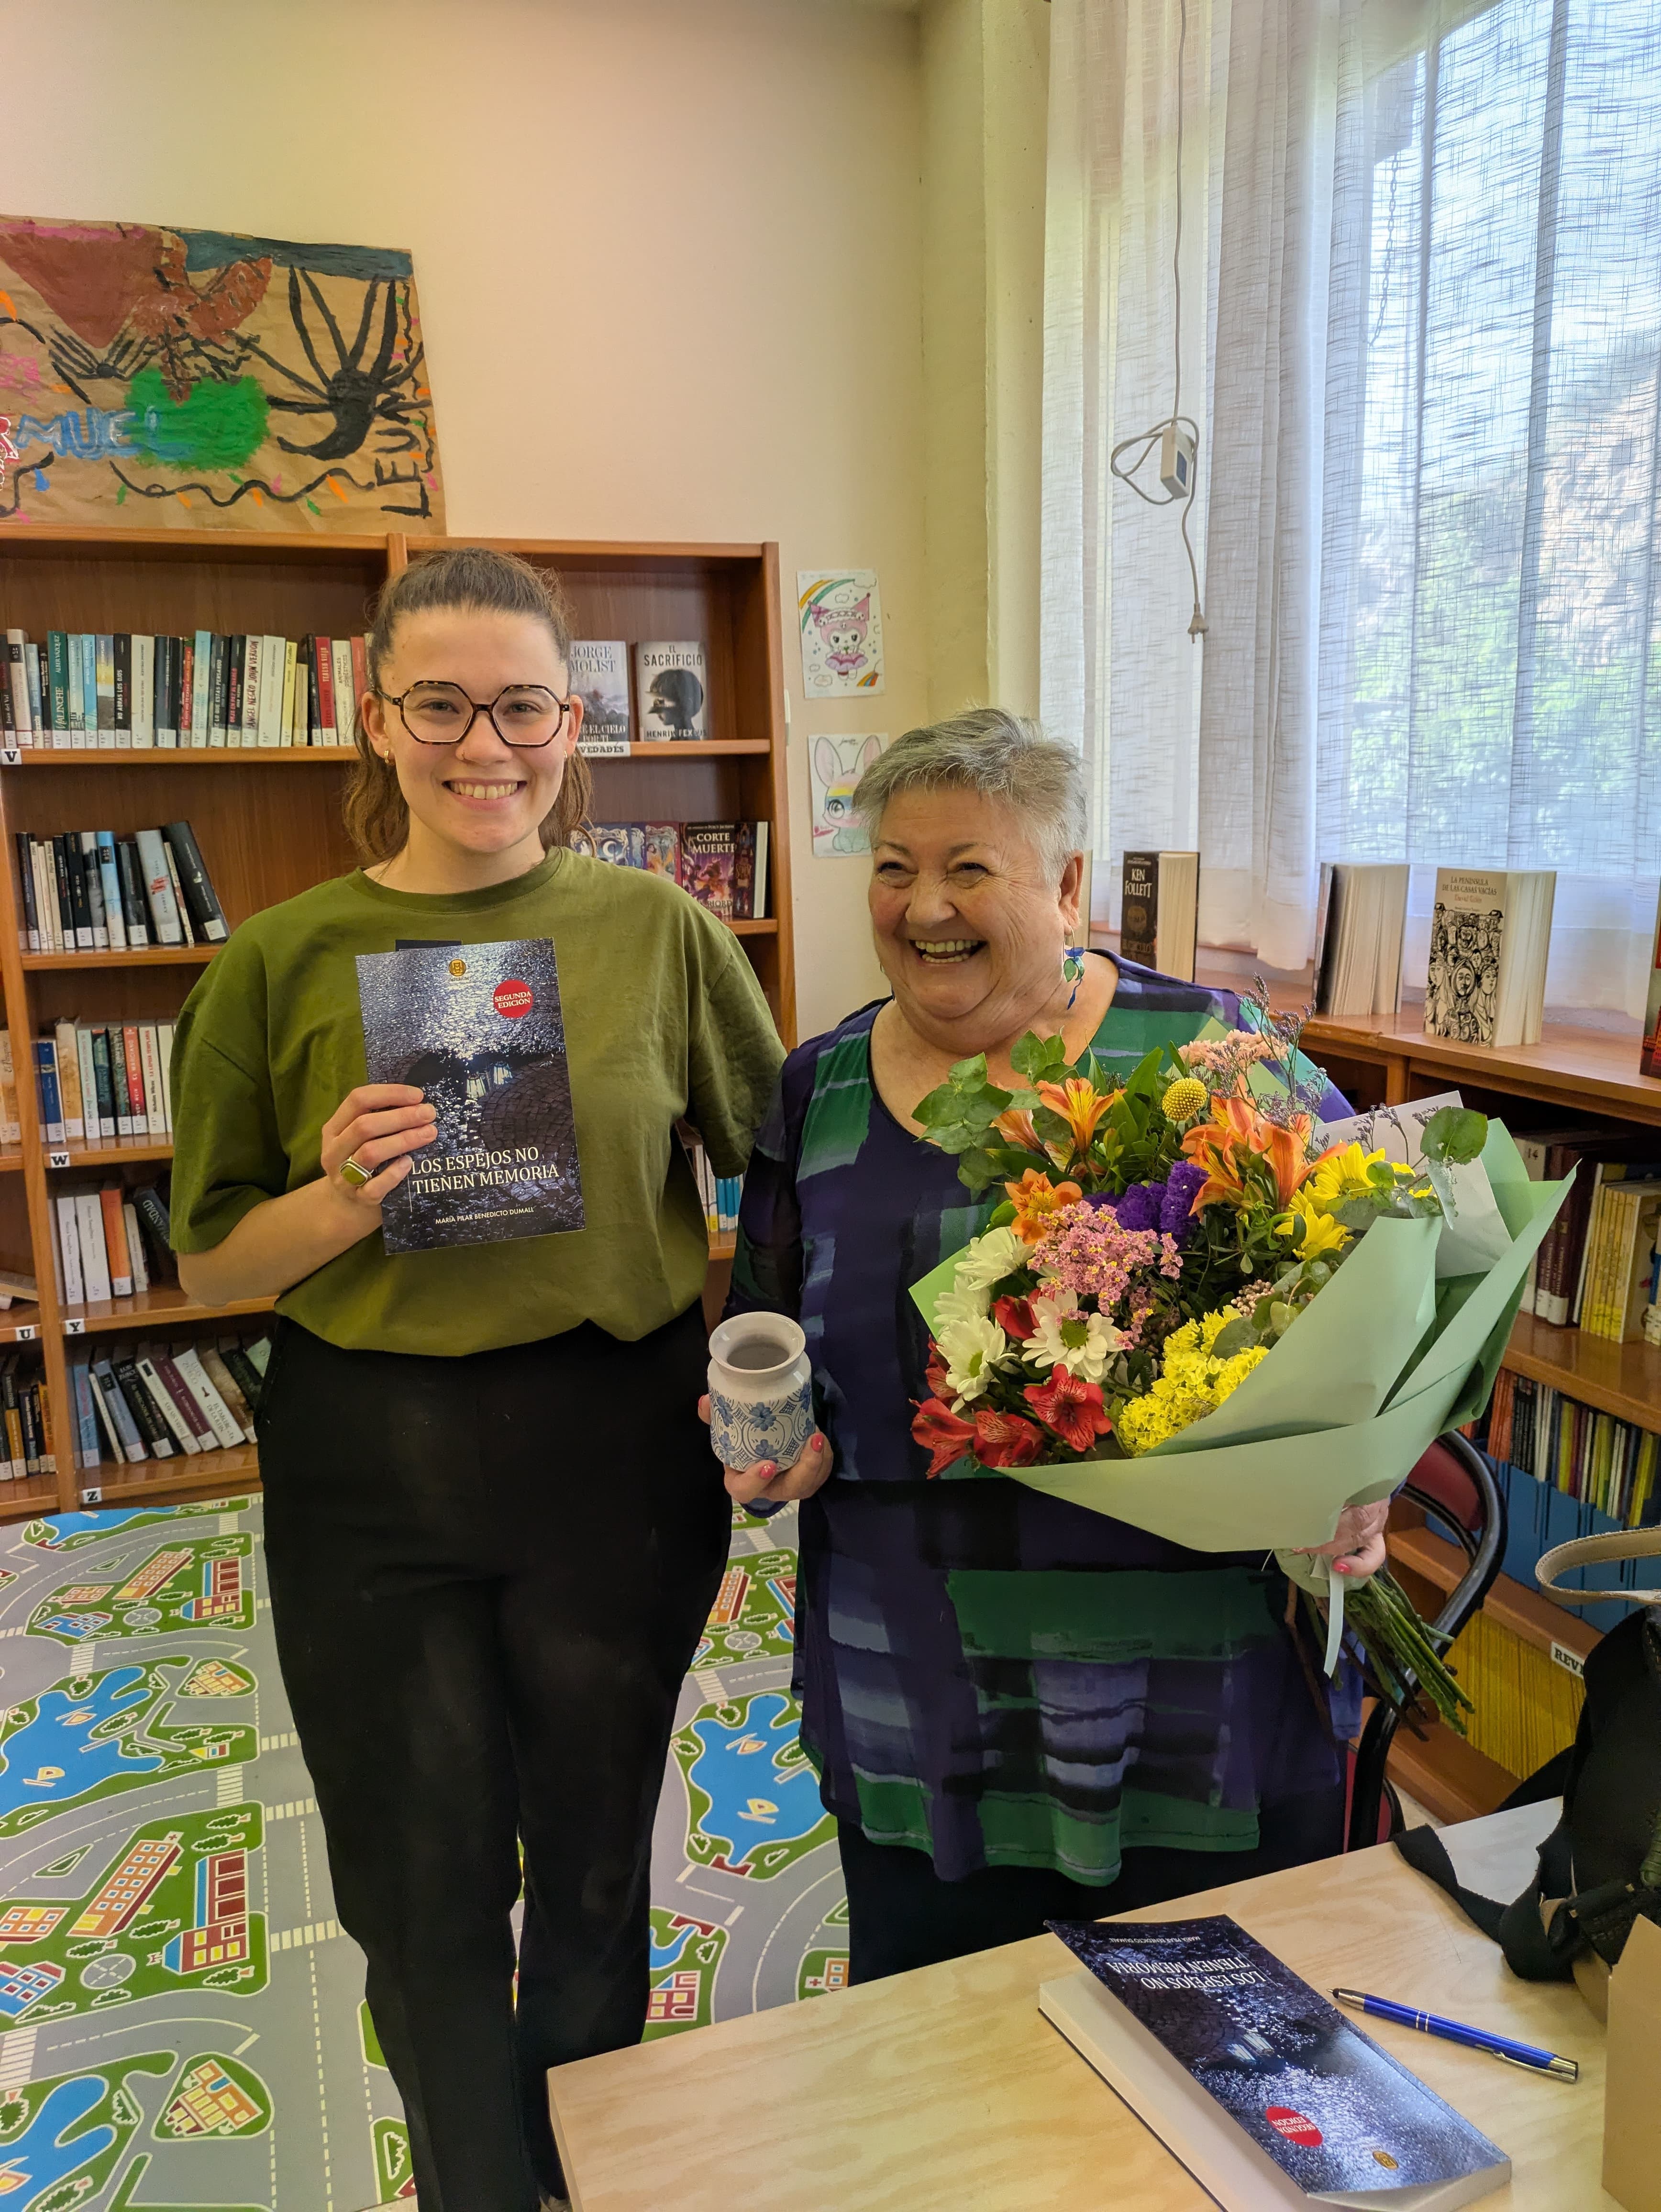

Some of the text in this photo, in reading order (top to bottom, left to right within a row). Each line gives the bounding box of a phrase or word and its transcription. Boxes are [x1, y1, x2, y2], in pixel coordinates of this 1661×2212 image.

[250, 641, 259, 664] VERDON
[571, 646, 612, 659] JORGE
[669, 644, 676, 653] EL
[644, 654, 703, 666] SACRIFICIO
[569, 660, 616, 672] MOLIST
[248, 666, 258, 683] JOHN
[247, 685, 256, 706] NEGRO
[602, 724, 626, 734] CIELO
[5, 752, 17, 763] V
[697, 832, 730, 841] CORTE
[1132, 868, 1145, 881] KEN
[1125, 880, 1152, 898] FOLLETT
[1461, 885, 1477, 893] CASAS
[495, 991, 532, 1002] SEGUNDA
[498, 998, 531, 1008] EDICIÓN
[51, 1155, 68, 1165] W
[412, 1147, 539, 1174] LOS ESPEJOS NO
[412, 1164, 559, 1194] TIENEN MEMORIA
[435, 1207, 534, 1224] MARÍA PILAR BENEDICTO DUMALL
[69, 1321, 81, 1332] Y
[20, 1328, 31, 1339] U
[87, 1491, 99, 1501] Z
[1106, 1957, 1251, 1973] TIENEN MEMORIA
[1141, 1970, 1266, 1989] LOS ESPEJOS NO
[1271, 2116, 1306, 2126] EDICIÓN
[1277, 2123, 1316, 2133] SEGUNDA
